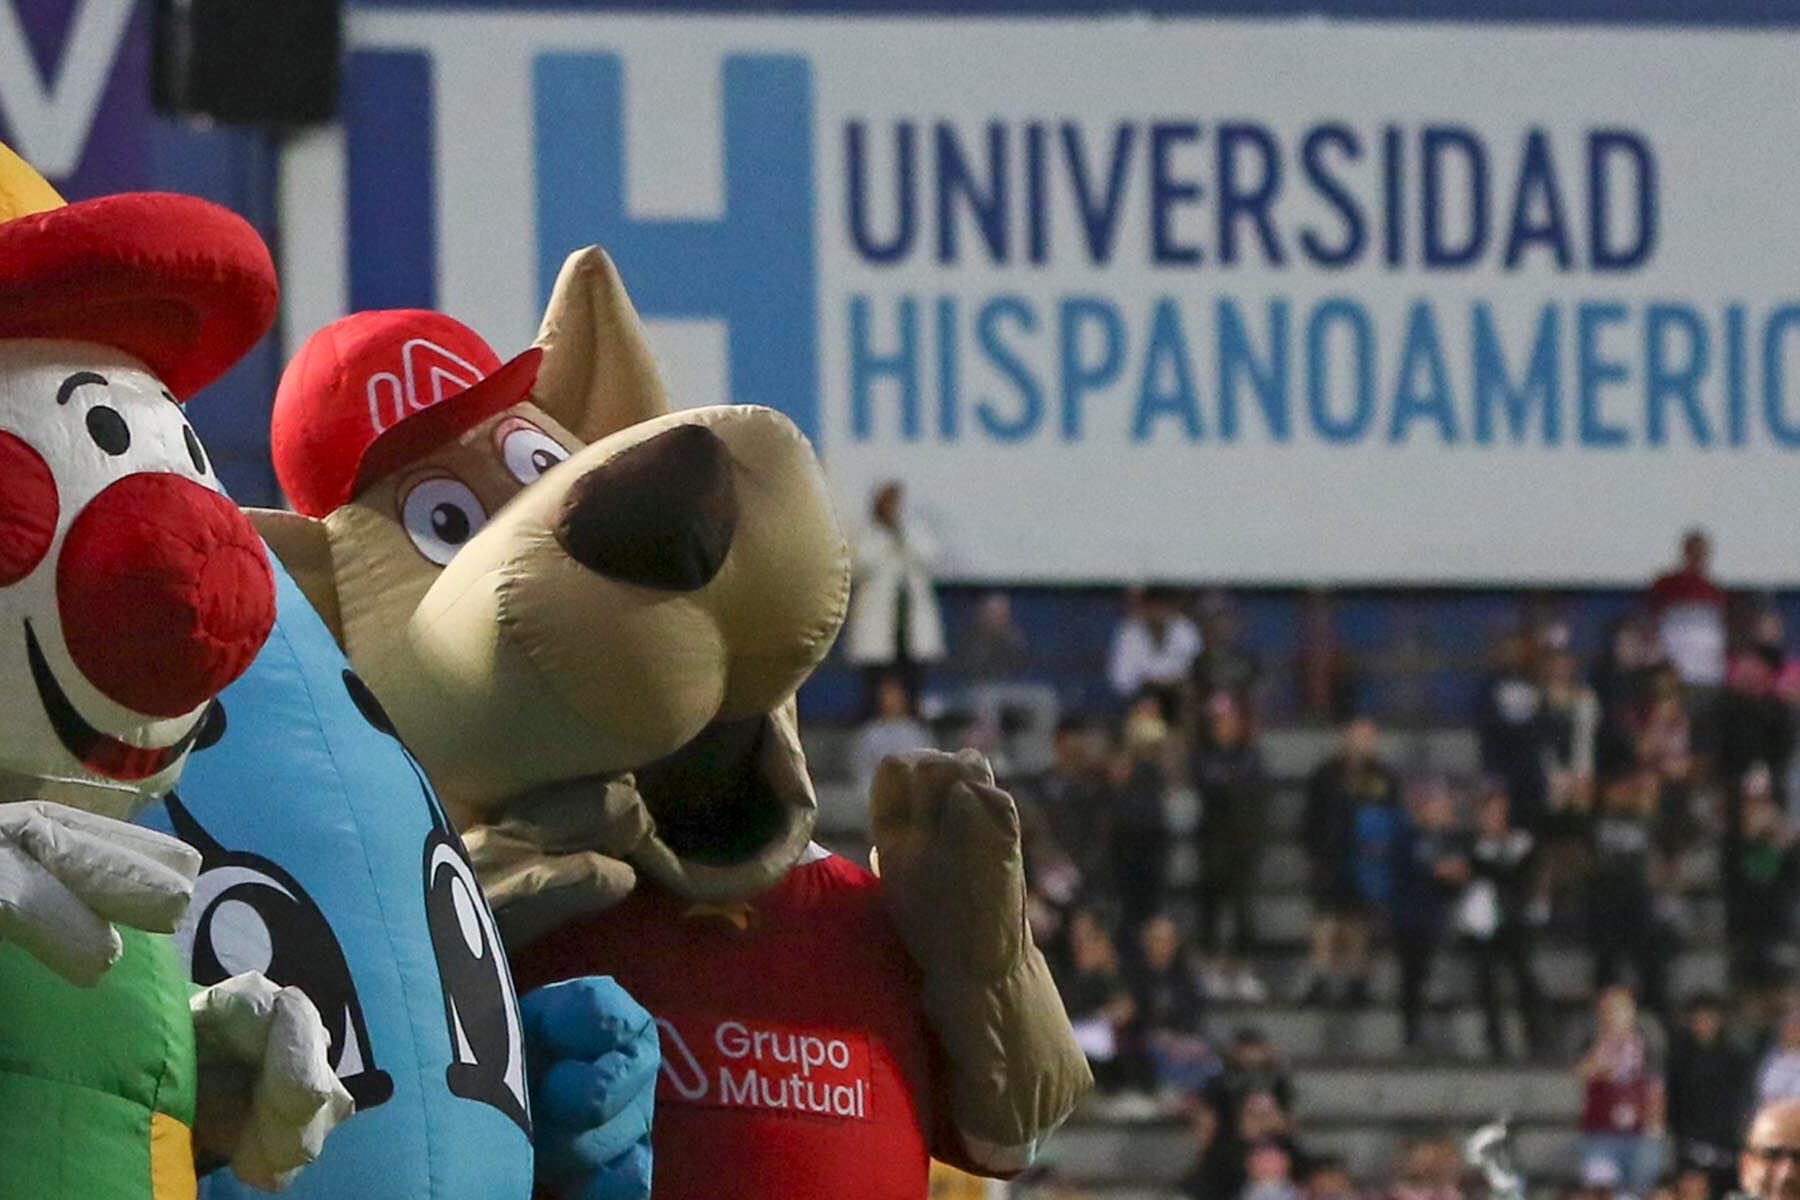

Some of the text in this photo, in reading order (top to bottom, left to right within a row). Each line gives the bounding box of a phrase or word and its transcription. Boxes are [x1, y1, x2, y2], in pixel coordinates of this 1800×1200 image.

[844, 116, 1660, 270] UNIVERSIDAD
[848, 293, 1800, 448] HISPANOAMERIC
[715, 1021, 849, 1077] Grupo
[719, 1067, 864, 1118] Mutual
